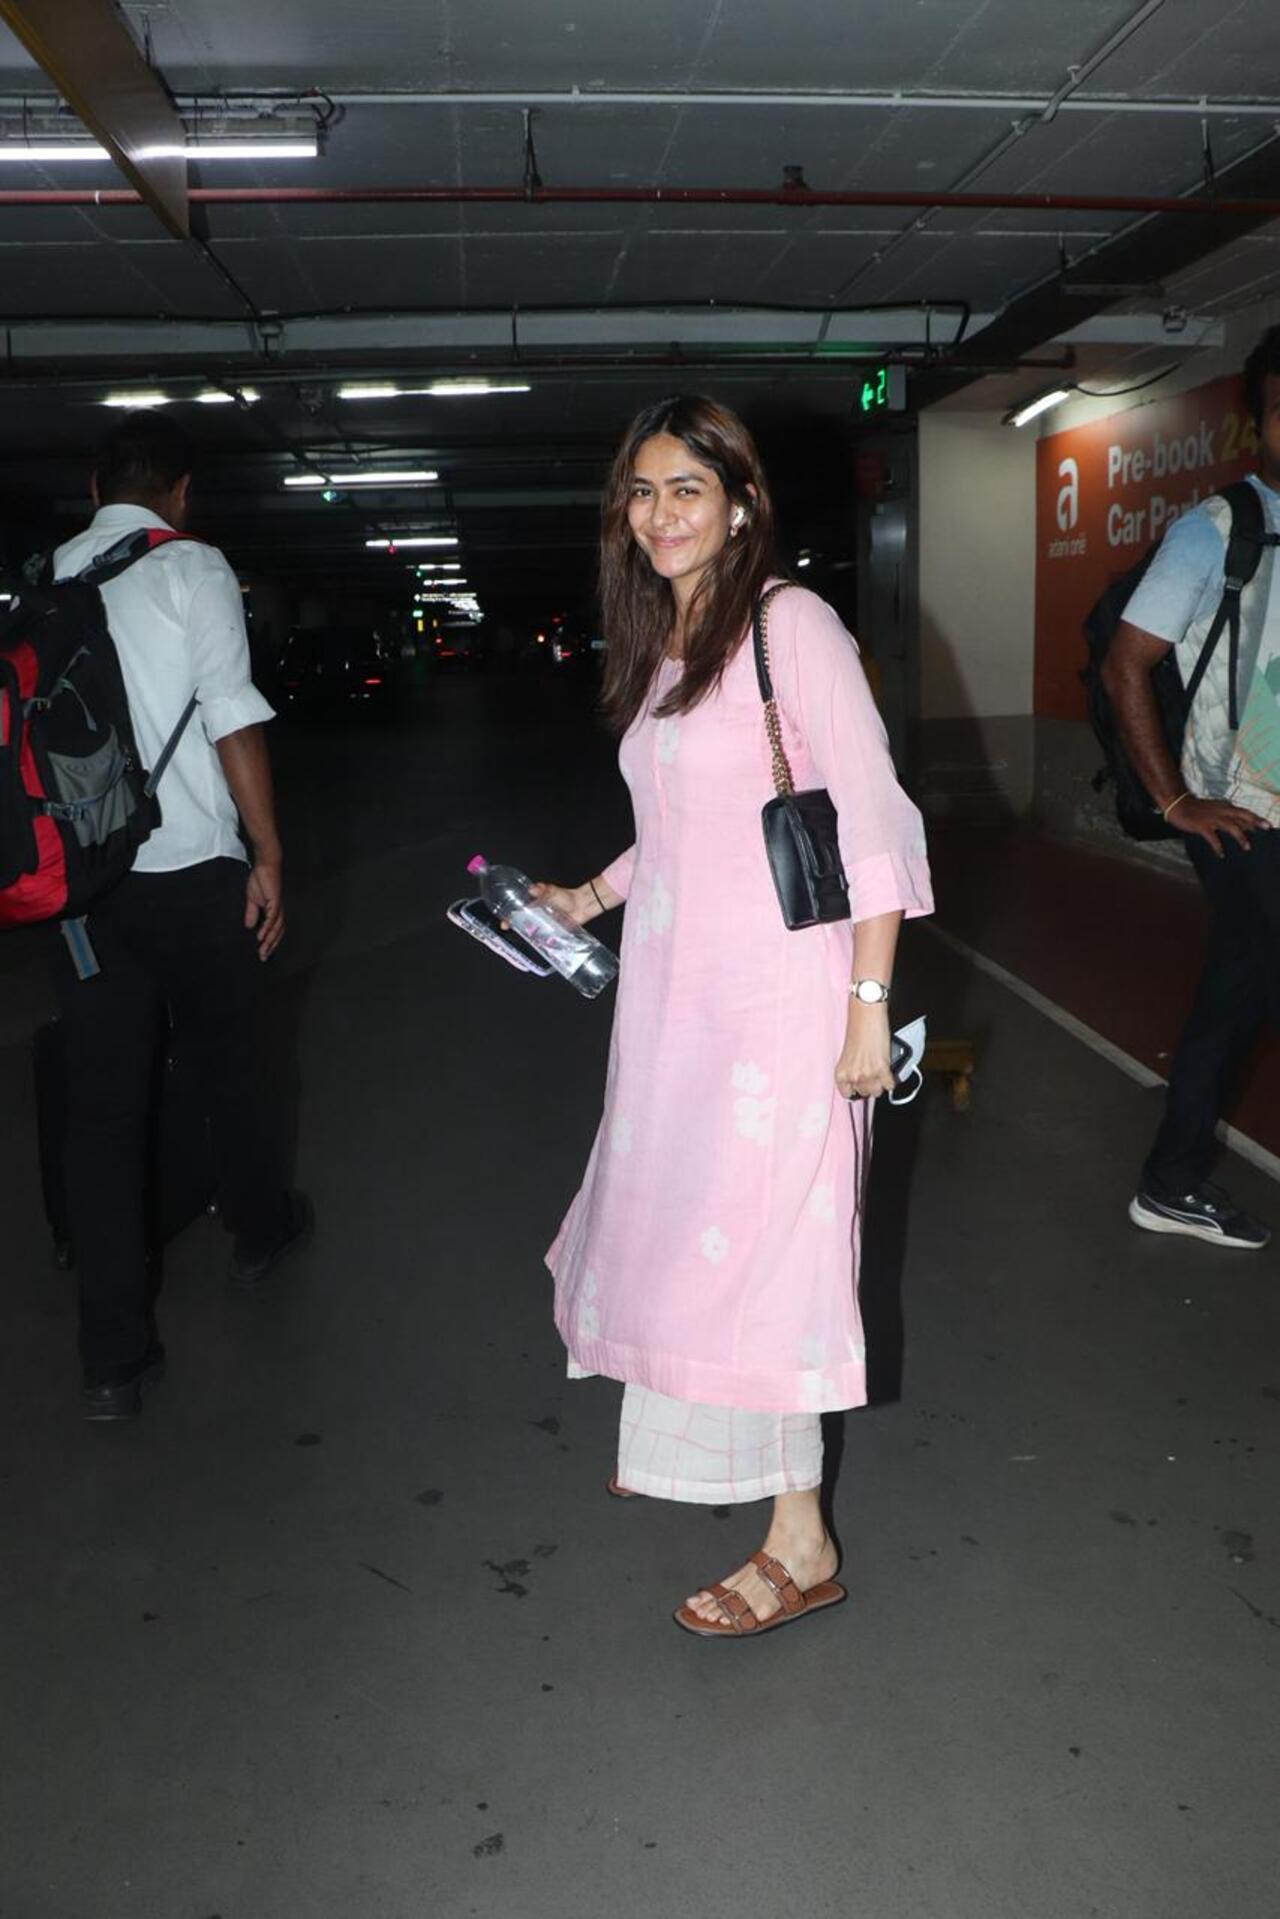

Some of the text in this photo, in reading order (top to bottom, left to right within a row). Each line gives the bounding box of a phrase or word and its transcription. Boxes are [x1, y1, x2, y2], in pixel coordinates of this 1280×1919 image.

[877, 370, 886, 404] 2
[1108, 422, 1216, 488] Pre-book
[1108, 503, 1145, 546] Car
